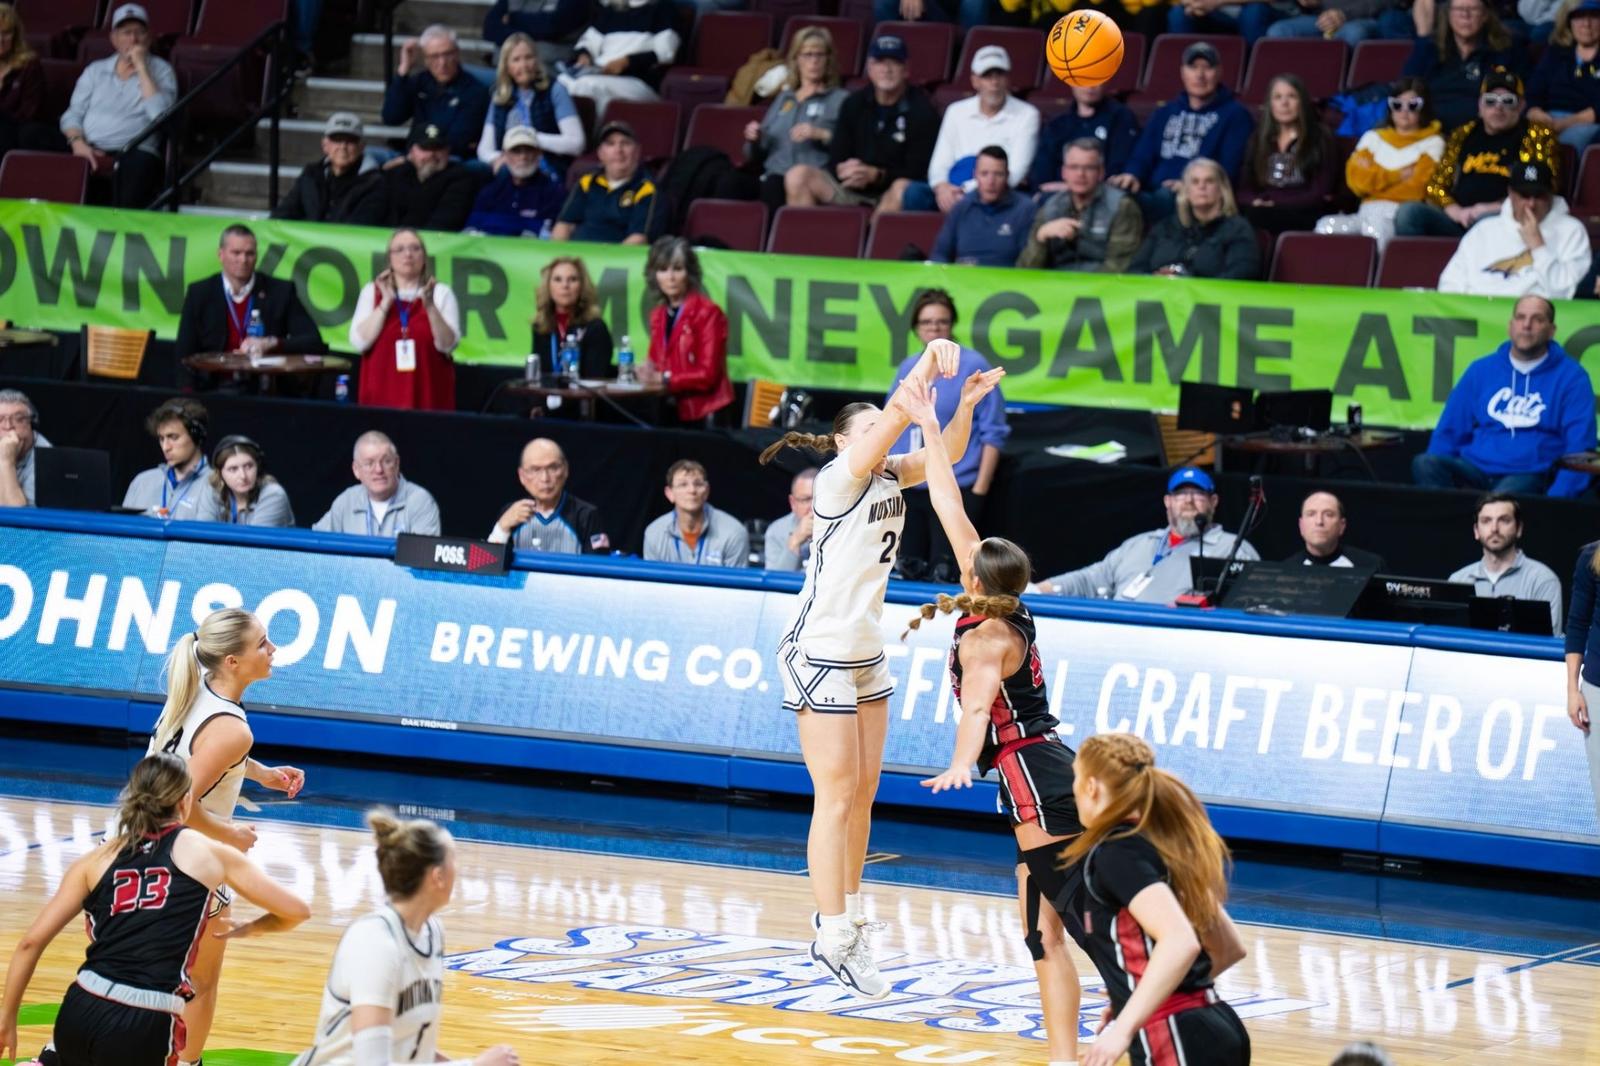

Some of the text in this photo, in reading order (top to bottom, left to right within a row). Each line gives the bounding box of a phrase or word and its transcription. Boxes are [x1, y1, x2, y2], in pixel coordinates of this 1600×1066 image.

[0, 224, 187, 315] WN
[971, 291, 1295, 391] GAME
[1334, 312, 1478, 402] AT
[434, 544, 467, 566] POSS.
[879, 531, 900, 563] 2
[430, 621, 669, 682] BREWING
[685, 645, 769, 692] CO.
[1095, 662, 1293, 755] CRAFT
[1302, 683, 1463, 773] BEER
[1475, 698, 1568, 781] OF
[401, 717, 457, 730] DAKTRONICS
[110, 866, 172, 916] 23
